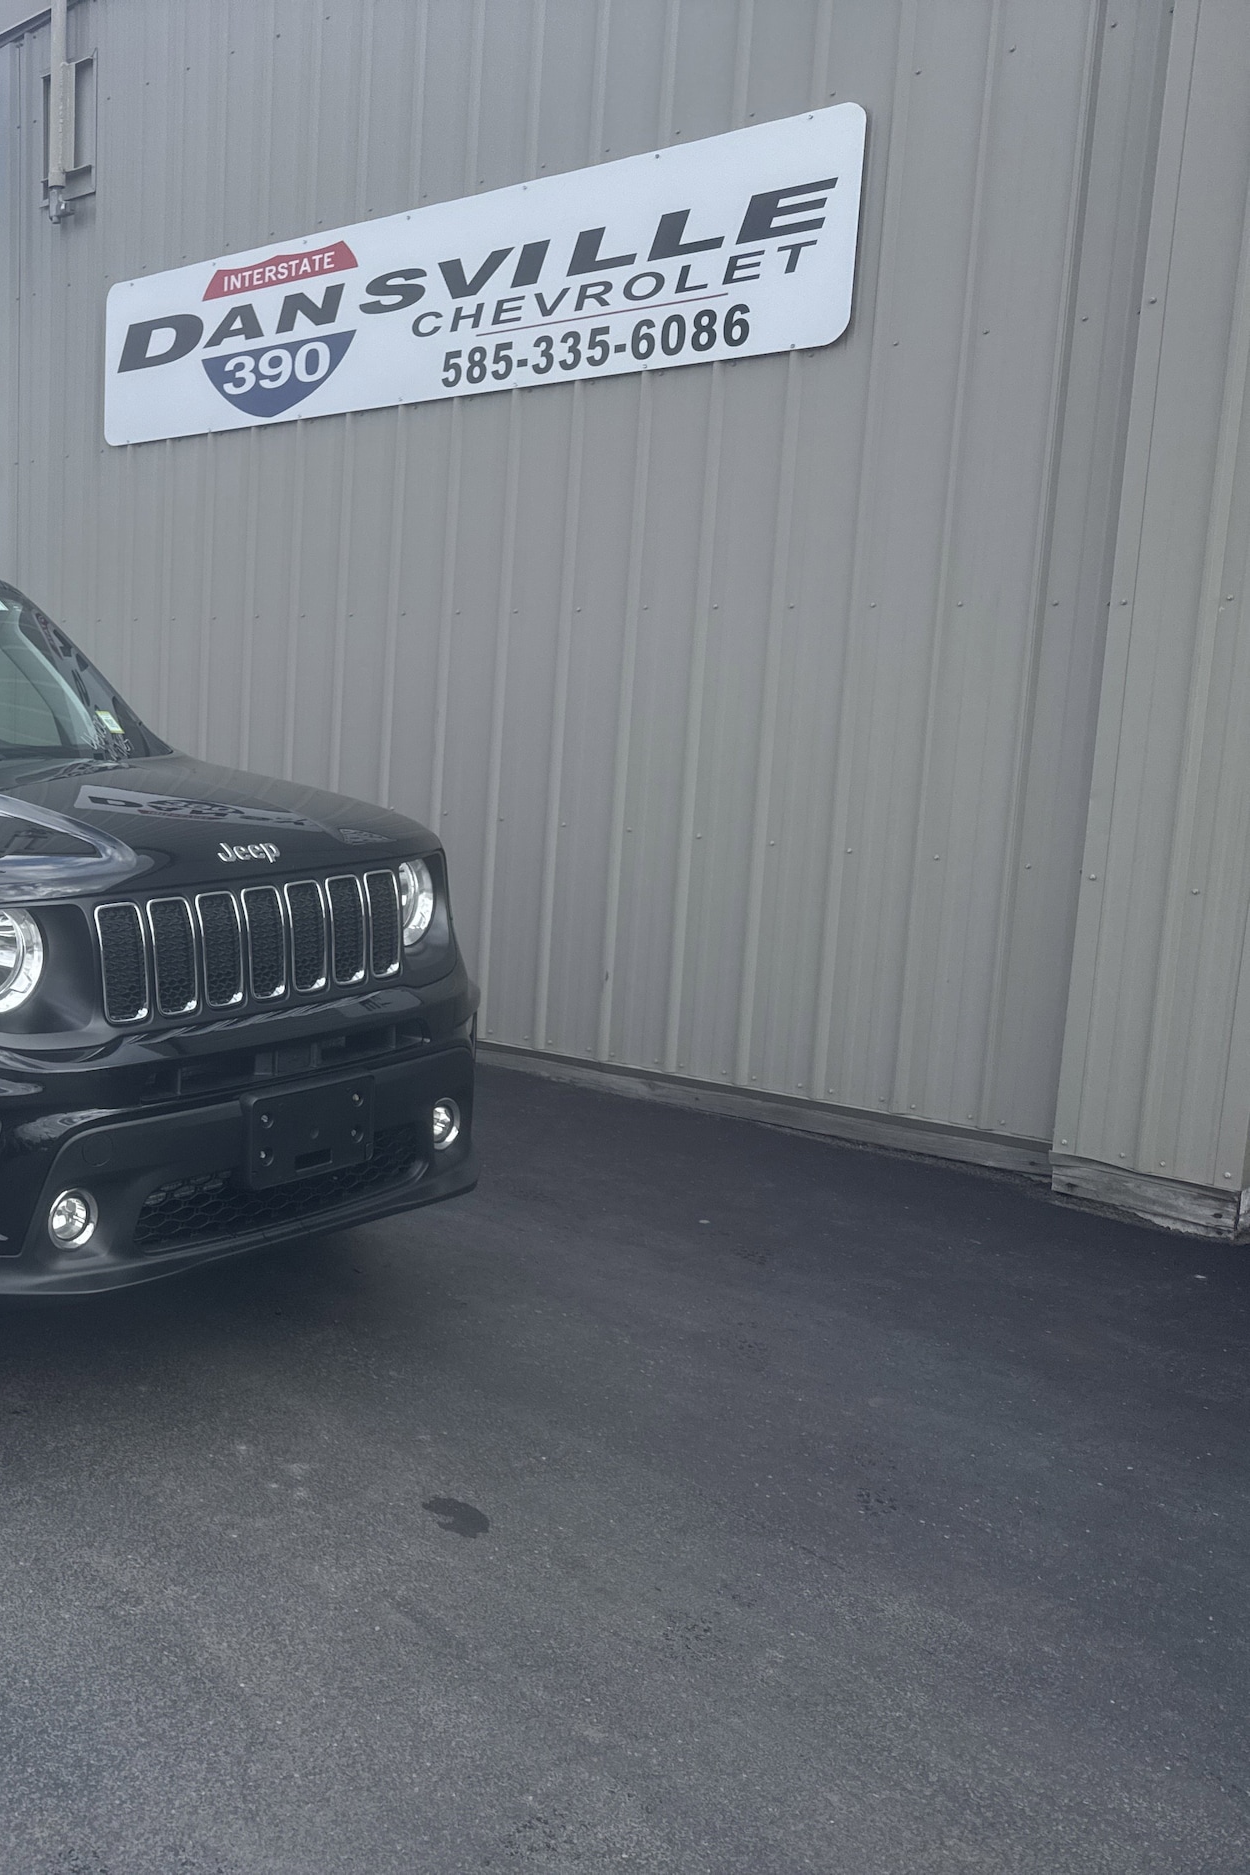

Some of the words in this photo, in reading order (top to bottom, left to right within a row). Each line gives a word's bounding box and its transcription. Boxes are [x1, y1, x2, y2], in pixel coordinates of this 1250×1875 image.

[223, 251, 335, 293] INTERSTATE
[411, 240, 818, 338] CHEVROLET
[222, 341, 330, 396] 390
[441, 303, 750, 388] 585-335-6086
[217, 842, 281, 863] Jeep
